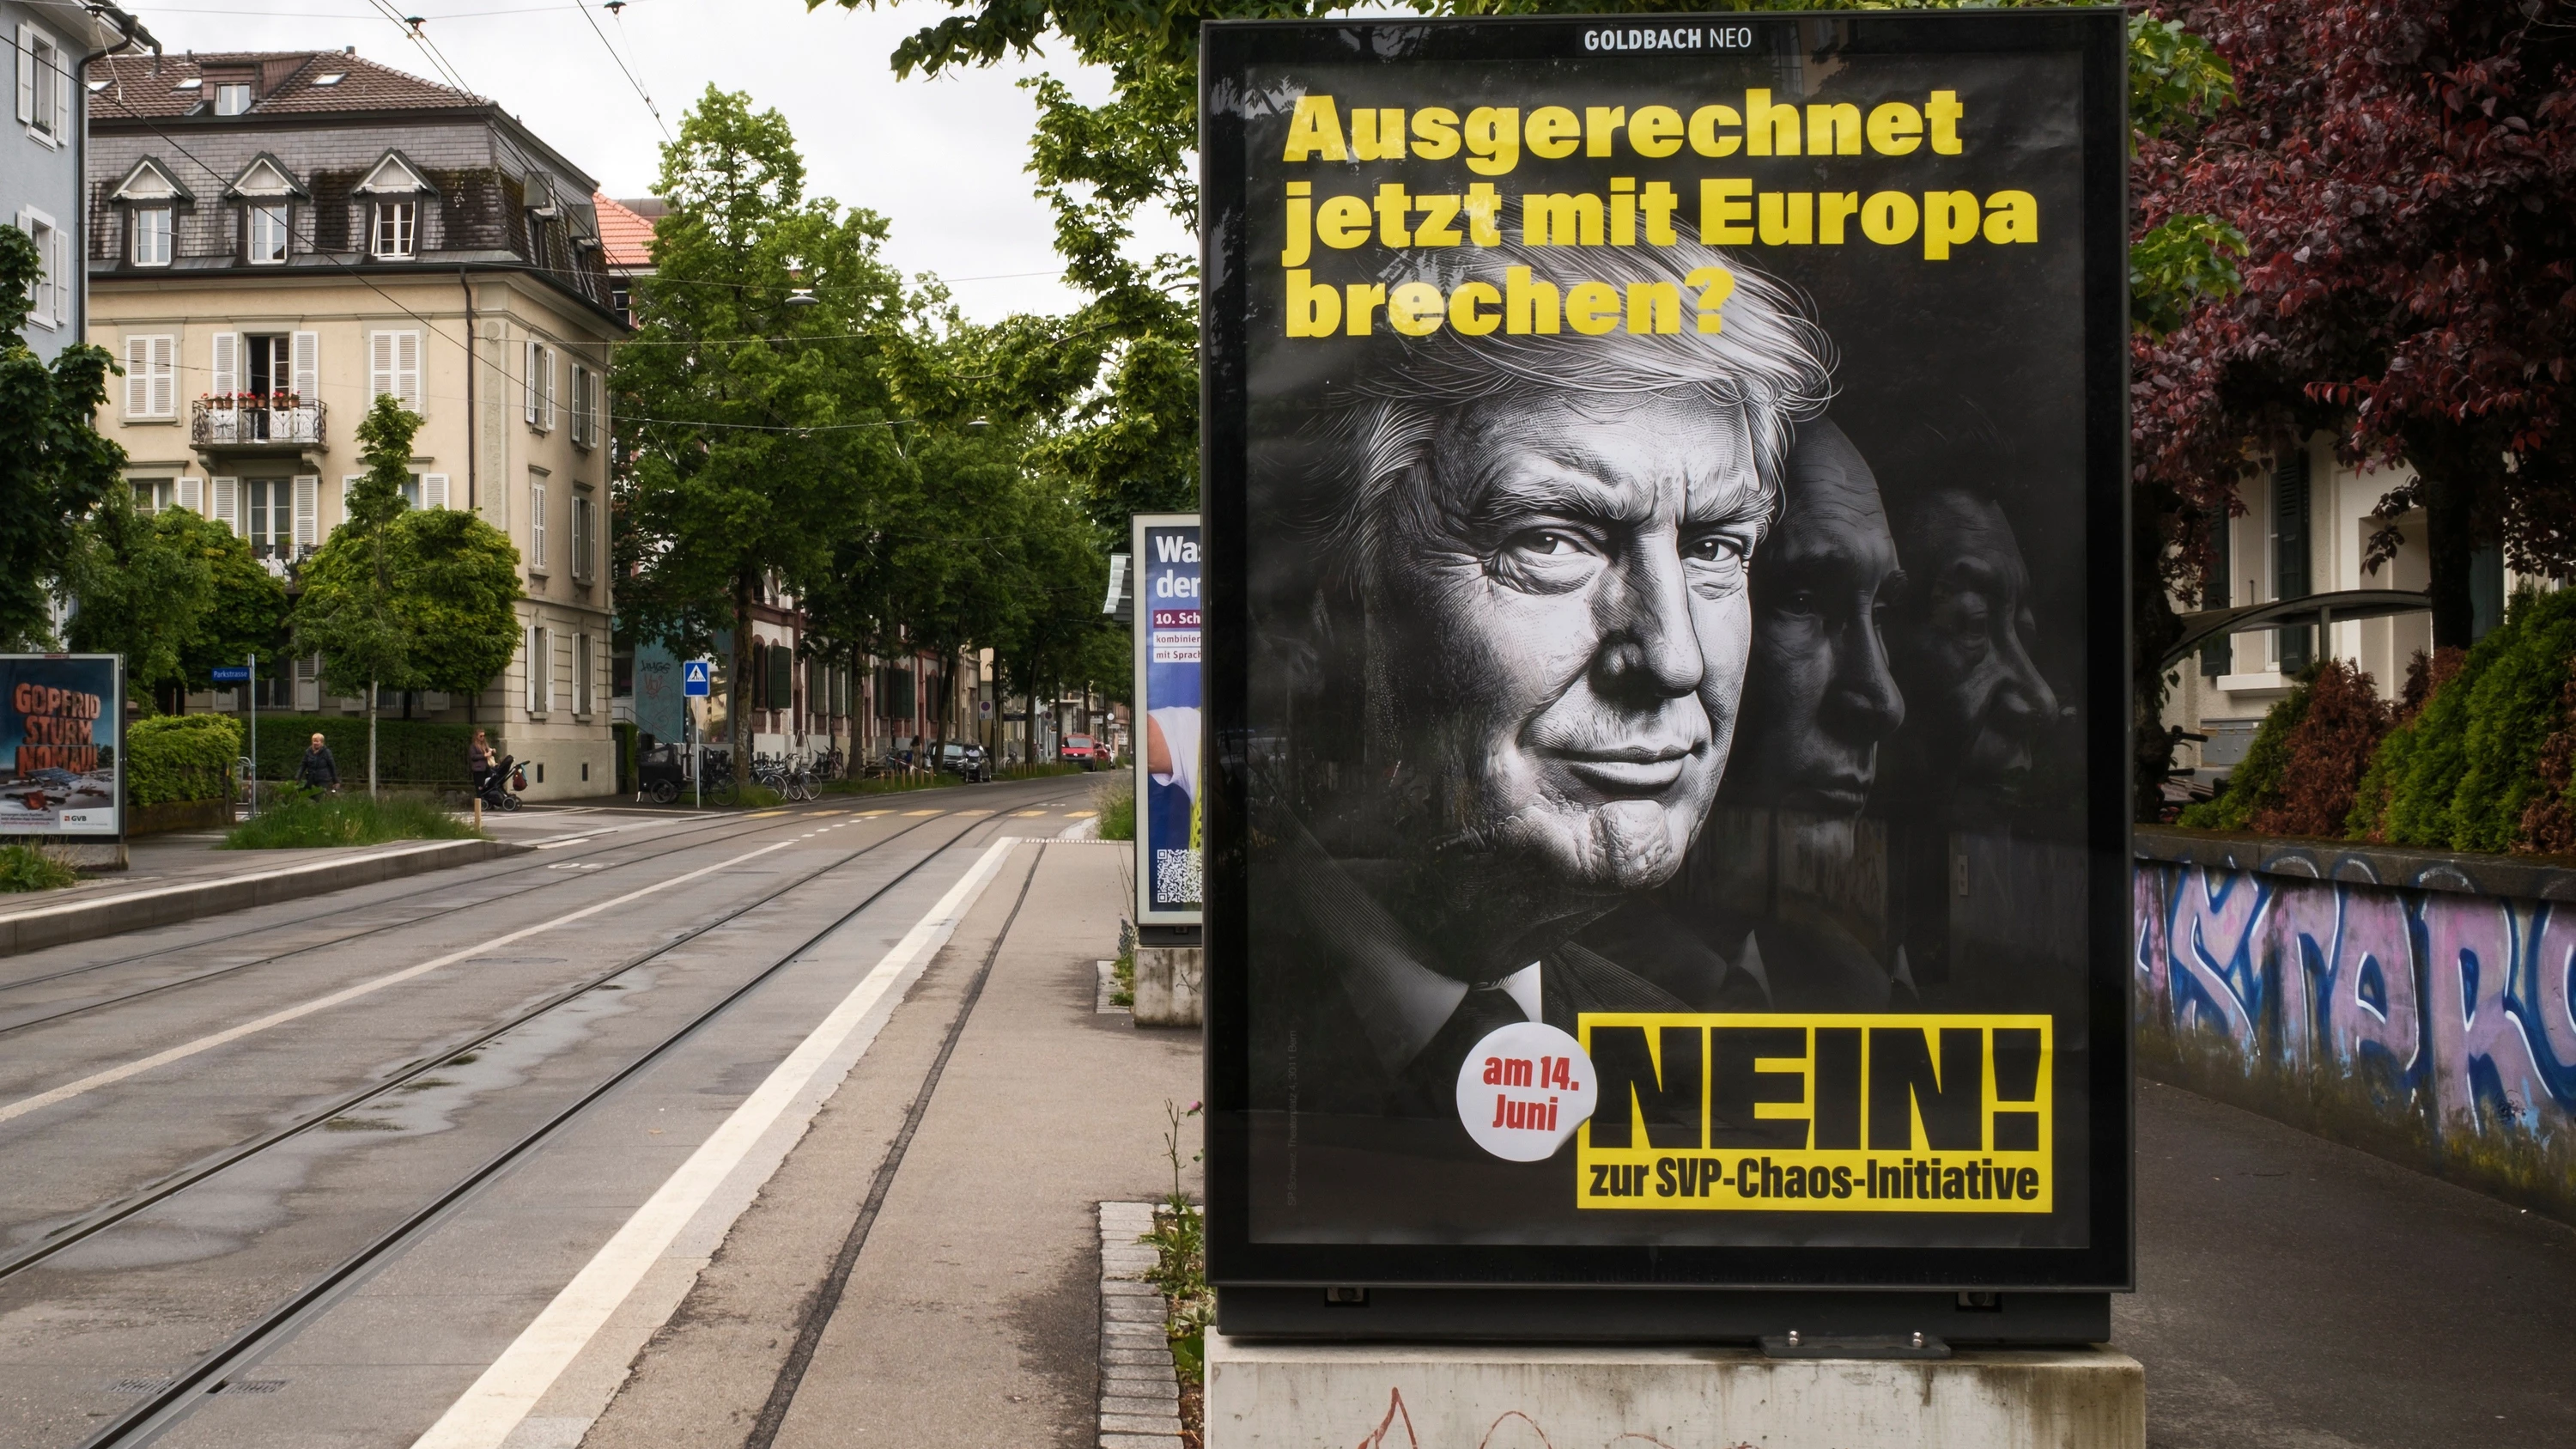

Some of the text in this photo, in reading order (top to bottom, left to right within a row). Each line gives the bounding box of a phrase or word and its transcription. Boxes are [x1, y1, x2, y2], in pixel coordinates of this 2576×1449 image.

[1584, 27, 1752, 50] GOLDBACH NEO
[1283, 88, 1964, 176] Ausgerechnet
[1281, 177, 2038, 266] jetzt mit Europa
[1285, 266, 1735, 338] brechen?
[1156, 612, 1201, 624] 10. Sch
[1156, 650, 1170, 659] mit
[213, 670, 248, 679] Parkstrasse
[13, 682, 101, 720] GOPFRID
[23, 715, 94, 746] STURM
[1287, 1030, 1297, 1052] Bern
[1287, 1056, 1297, 1081] 3011
[1483, 1056, 1580, 1091] am 14.
[1589, 1026, 2042, 1151] NEIN!
[1492, 1093, 1558, 1131] Juni
[1589, 1156, 2040, 1200] zur SVP-Chaos-Initiative
[1286, 1191, 1297, 1207] SP
